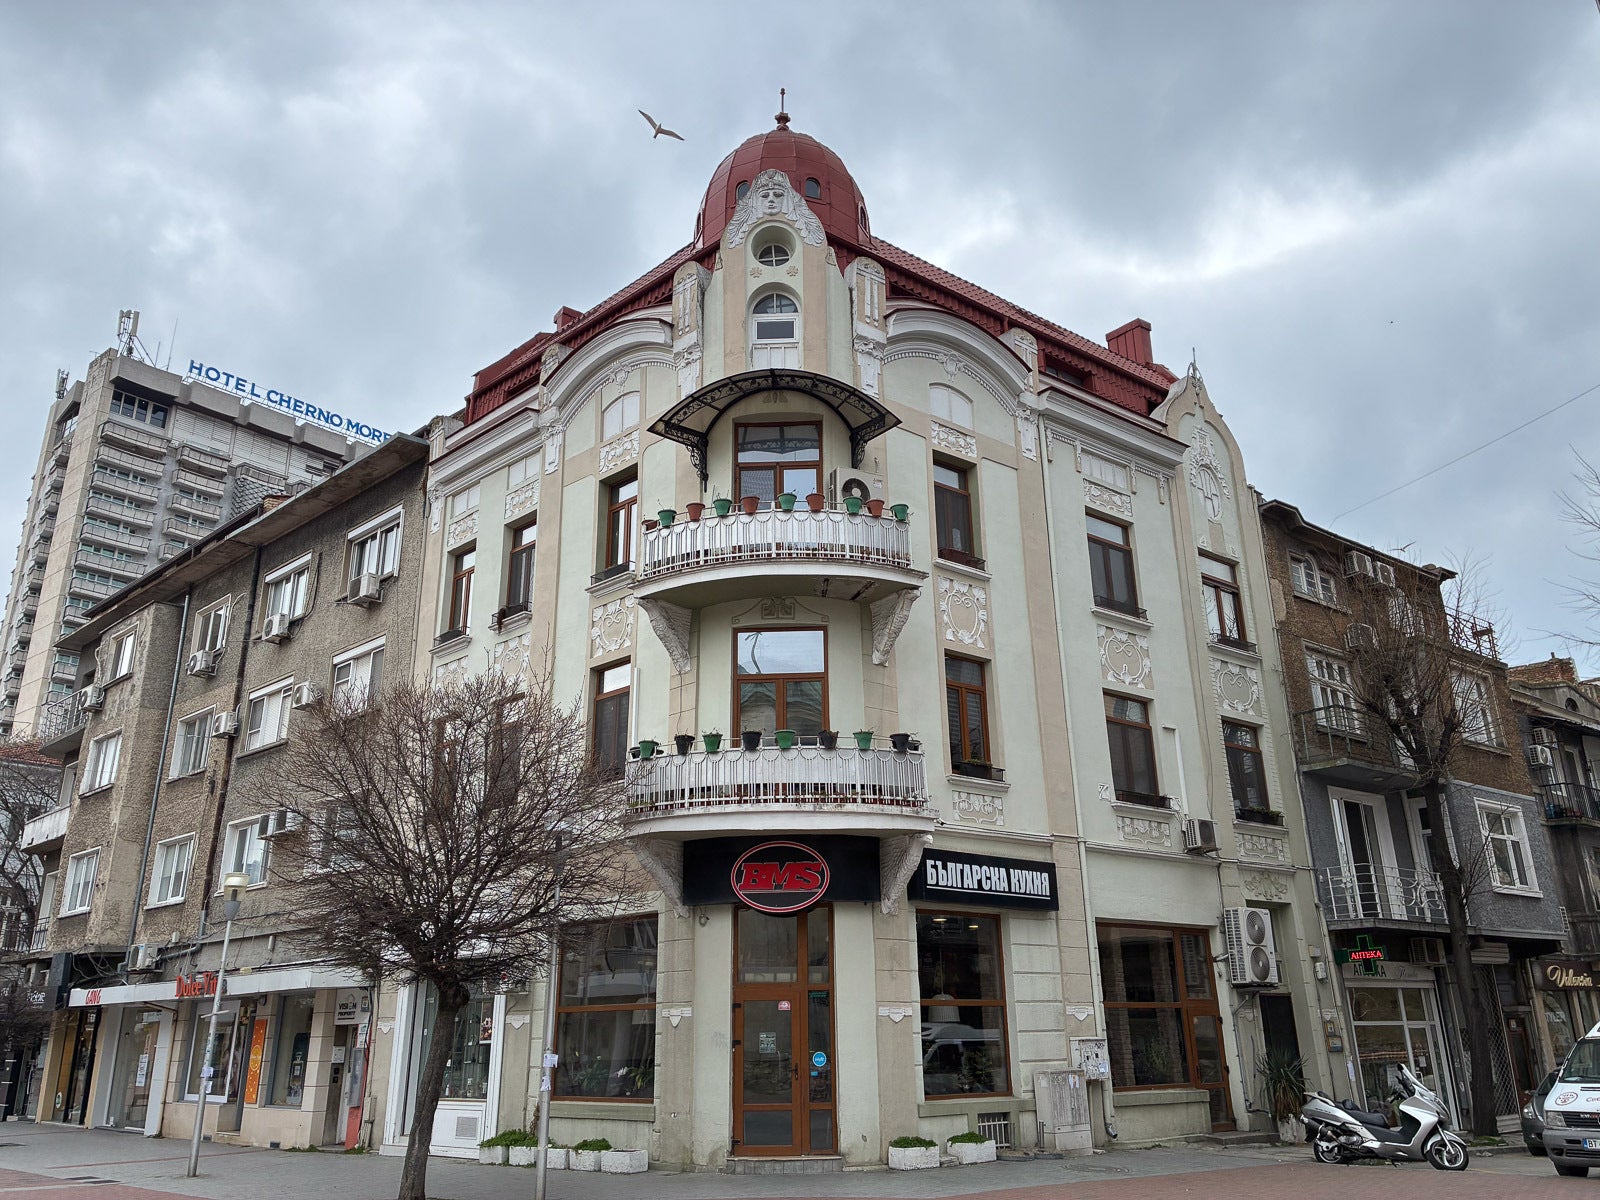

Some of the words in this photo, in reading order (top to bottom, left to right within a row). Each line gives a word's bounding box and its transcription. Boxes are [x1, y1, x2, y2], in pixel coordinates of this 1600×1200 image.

[188, 359, 261, 398] HOTEL
[266, 389, 343, 427] CHERNO
[737, 861, 822, 891] BMS
[925, 858, 1009, 892] БЪЛГАРСКА
[1009, 867, 1050, 896] КУХНЯ
